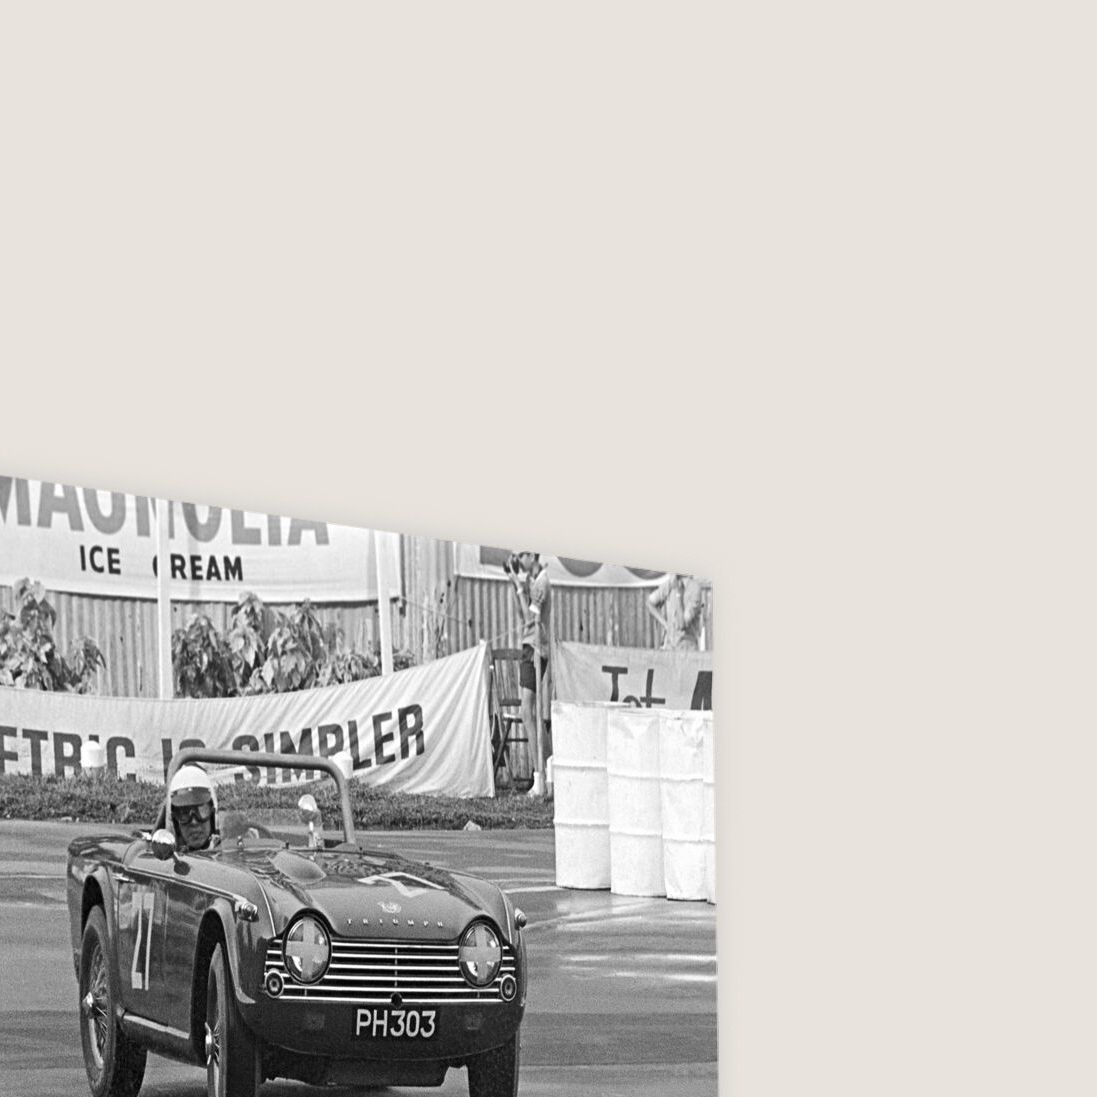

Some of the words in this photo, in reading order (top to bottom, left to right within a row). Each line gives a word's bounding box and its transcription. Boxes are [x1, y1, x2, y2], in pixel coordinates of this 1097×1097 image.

[79, 544, 122, 576] ICE
[232, 703, 425, 786] SIMPLER
[347, 917, 444, 928] TRIUMPH
[355, 1008, 437, 1039] PH303
